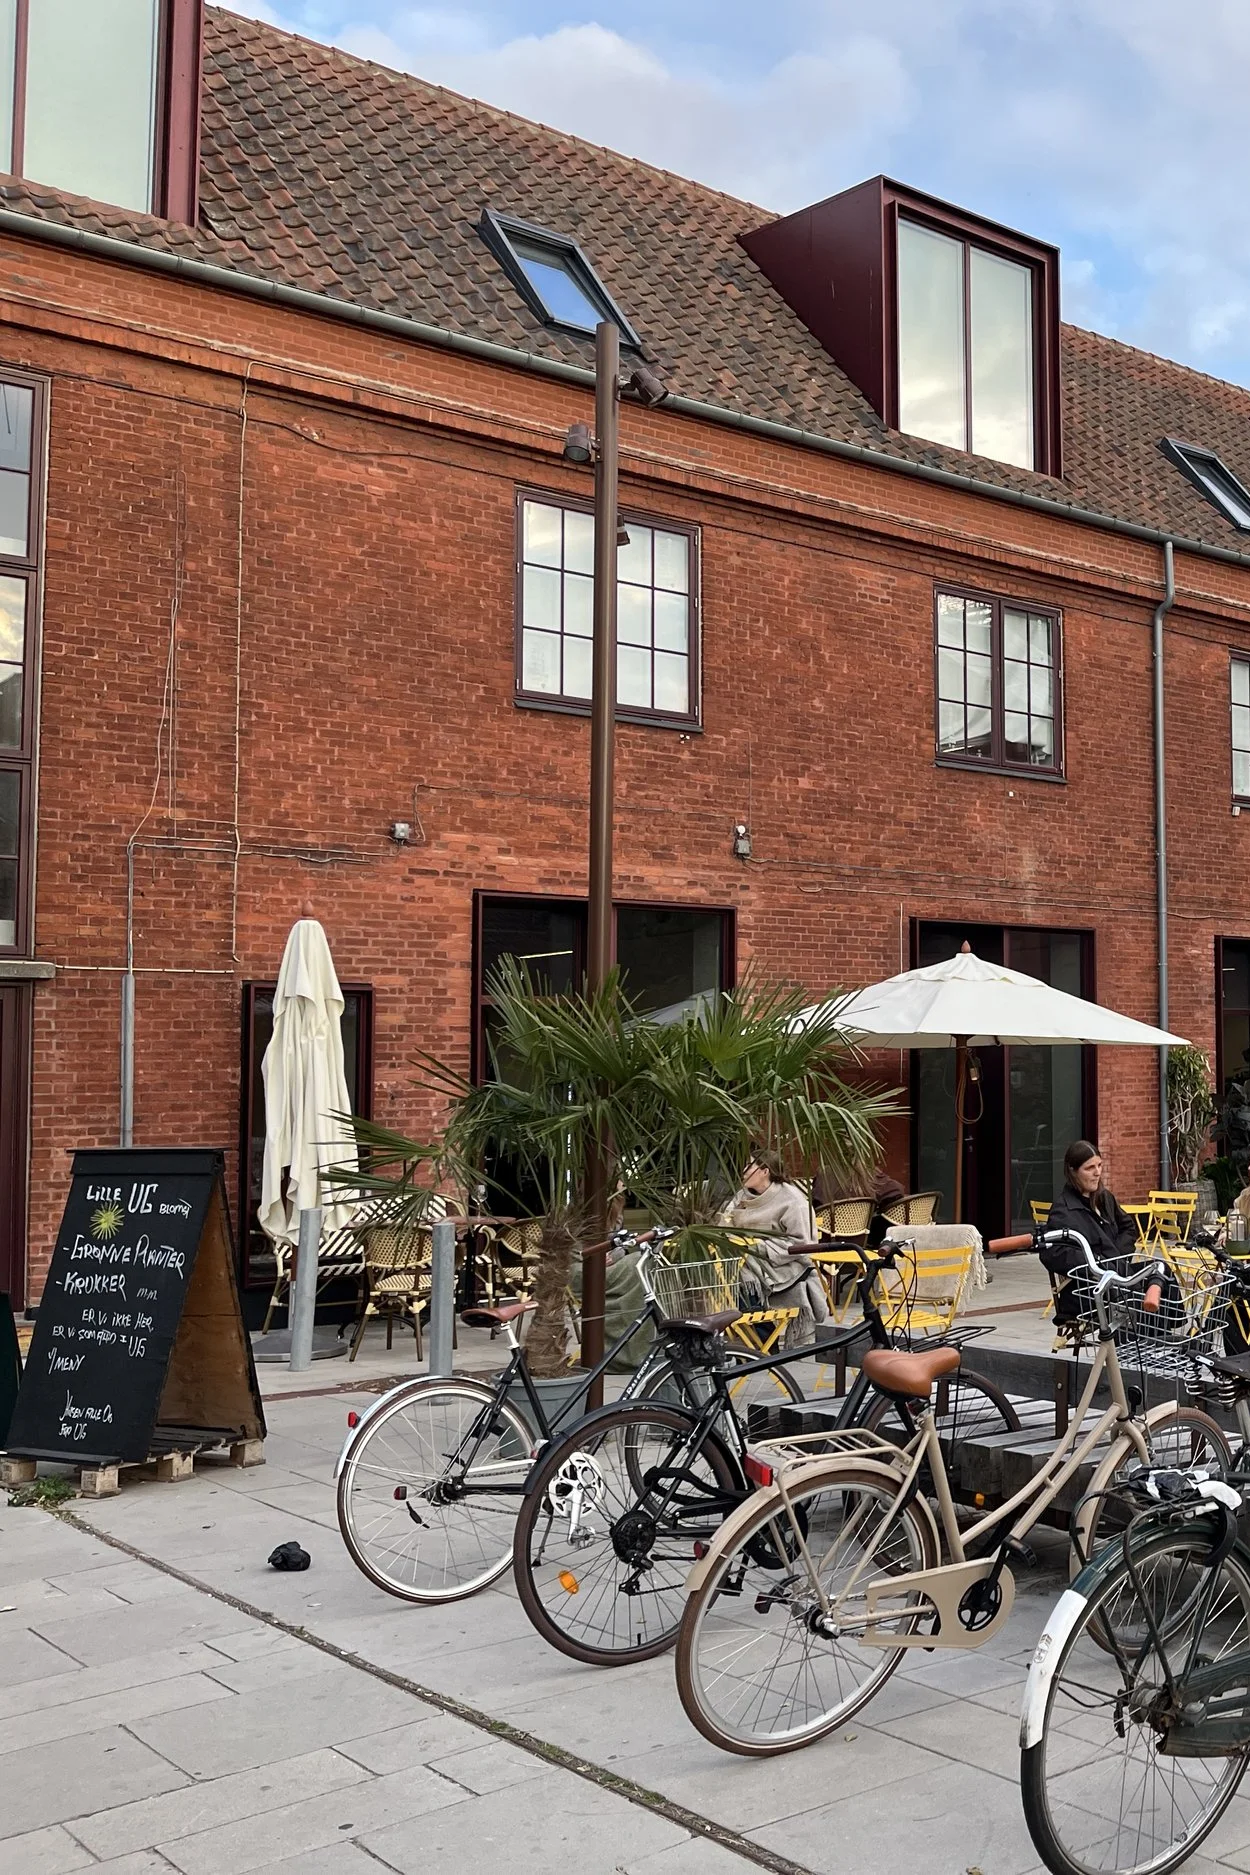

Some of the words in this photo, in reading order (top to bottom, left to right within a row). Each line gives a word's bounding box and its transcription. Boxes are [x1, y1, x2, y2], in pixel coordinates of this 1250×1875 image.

[128, 1183, 159, 1214] UG
[82, 1308, 96, 1326] ER
[52, 1325, 66, 1339] ER
[128, 1336, 147, 1358] UG
